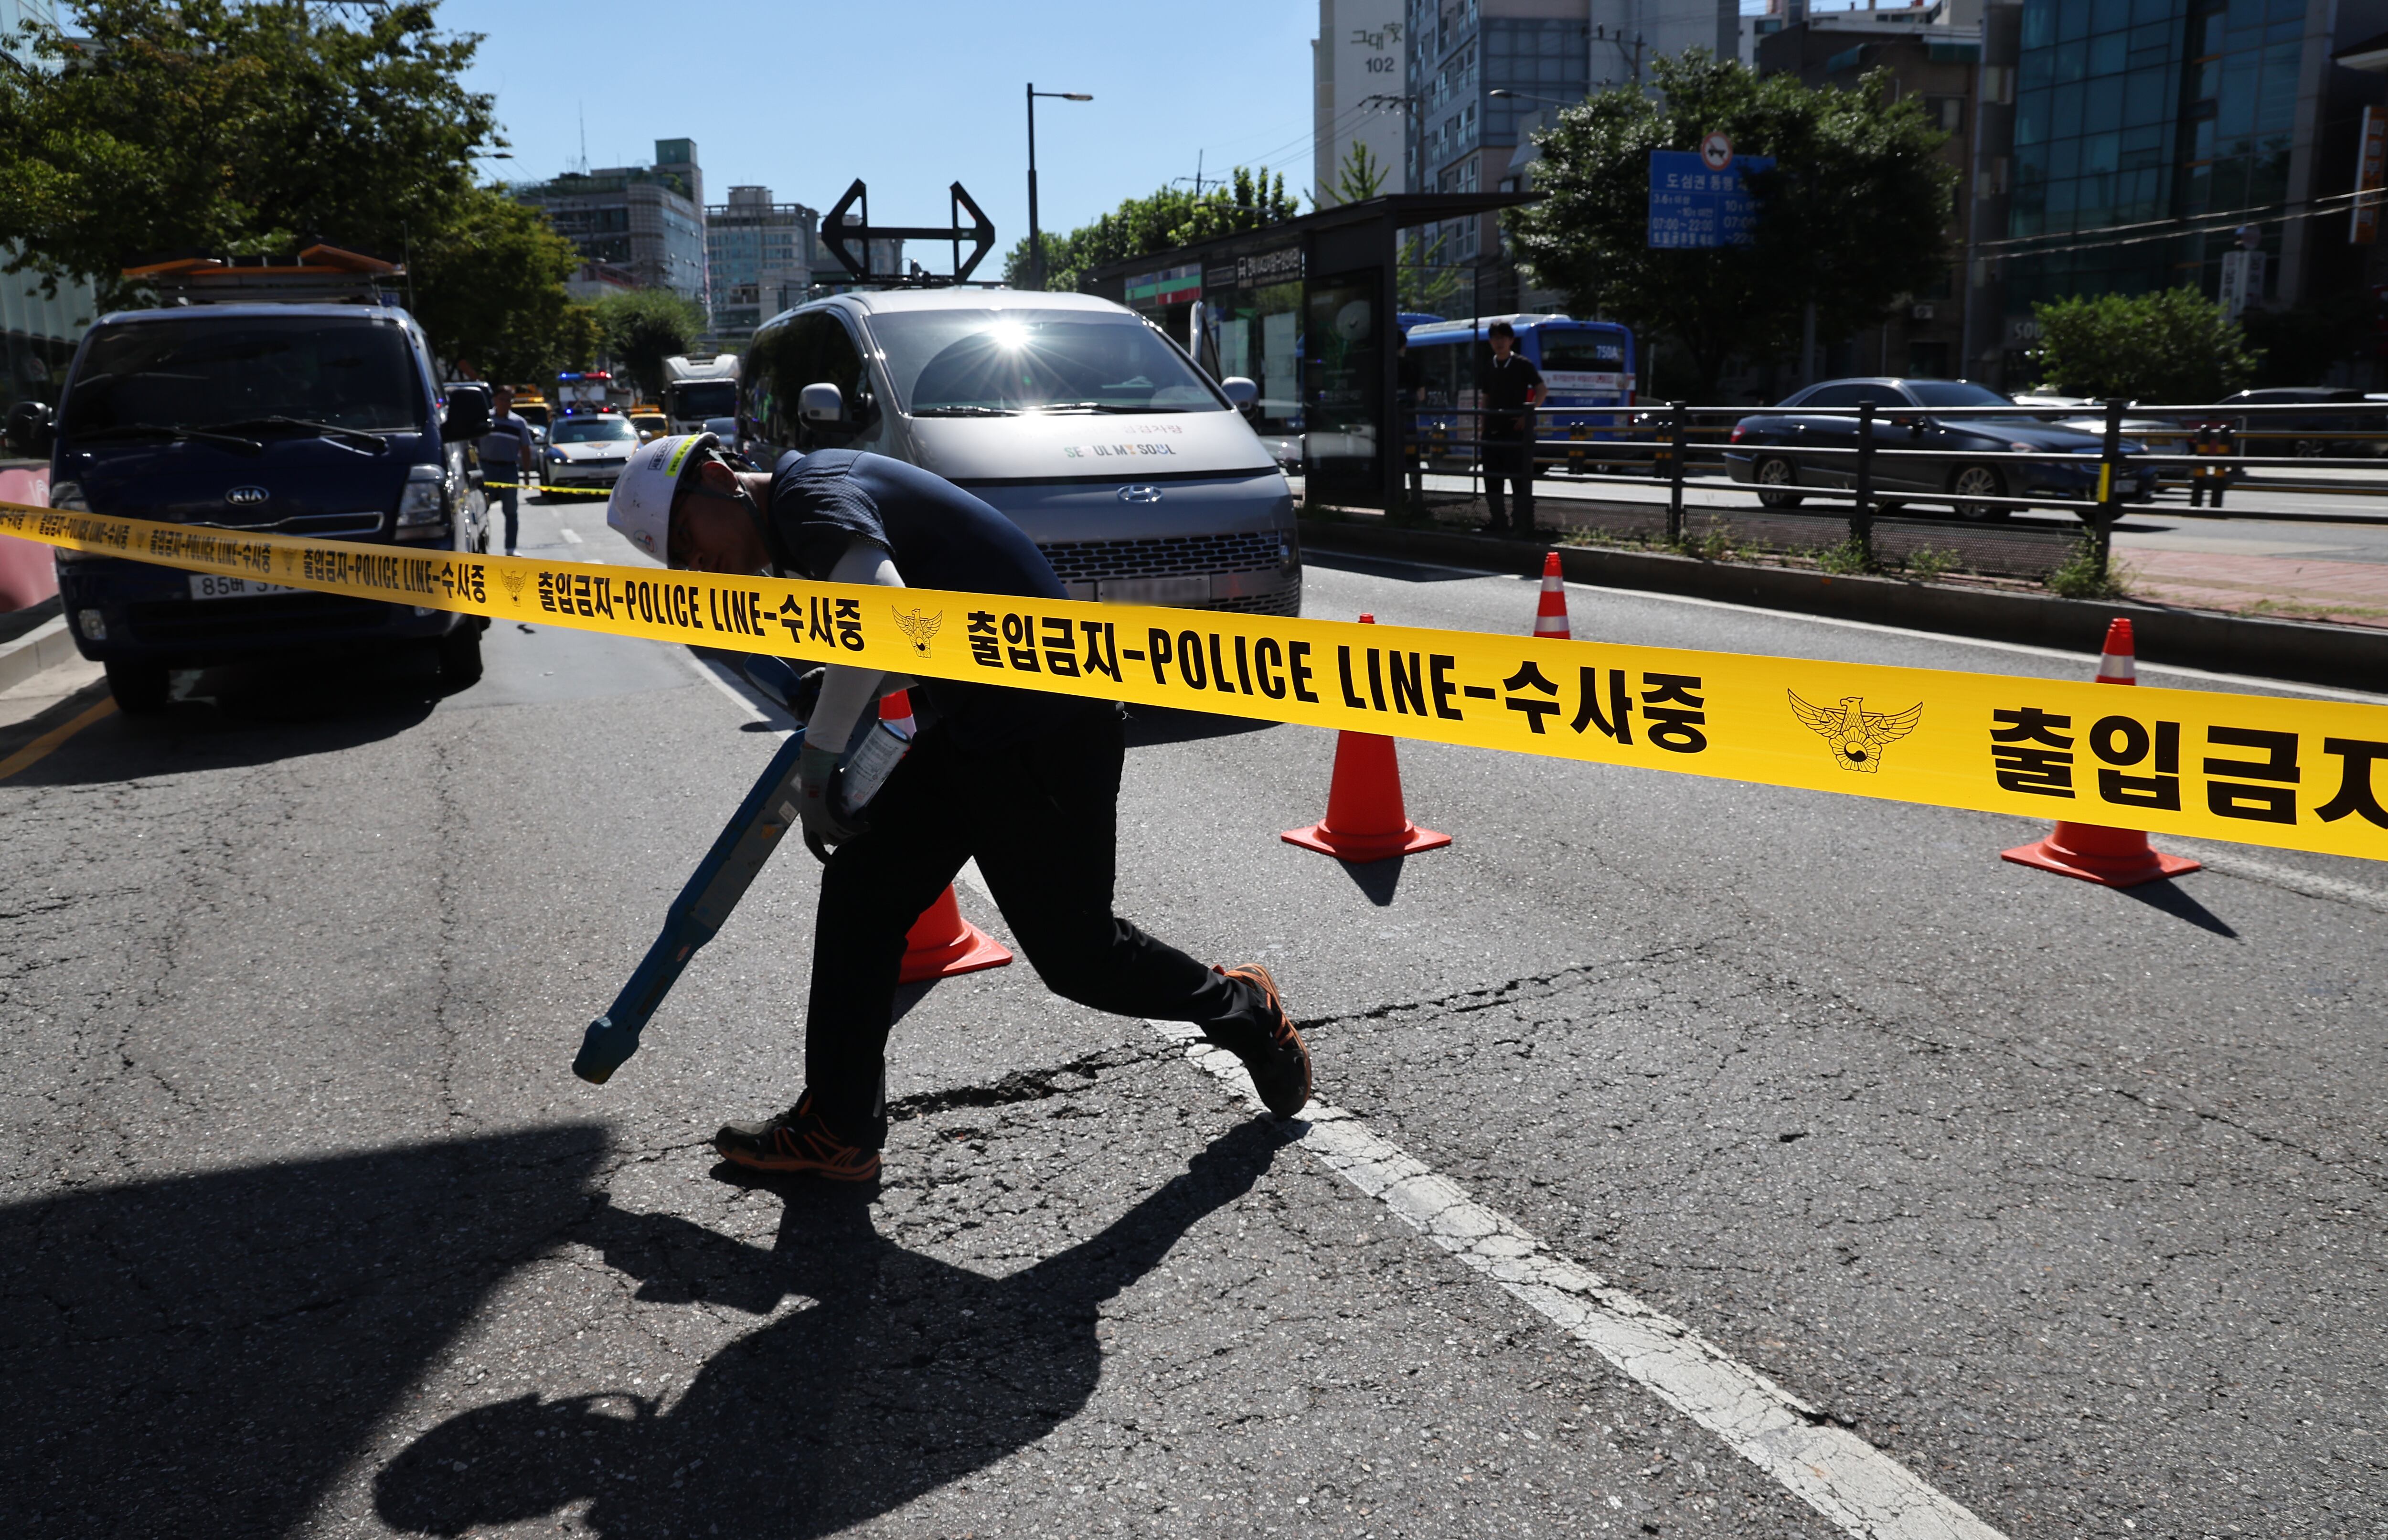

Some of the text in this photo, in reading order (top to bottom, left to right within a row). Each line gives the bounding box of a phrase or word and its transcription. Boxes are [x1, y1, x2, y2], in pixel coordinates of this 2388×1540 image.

[1365, 57, 1394, 73] 102
[1666, 173, 1706, 190] 도심권
[233, 489, 262, 502] KIA
[538, 571, 865, 652] 출입금지-POLICE LINE-수사중
[966, 610, 1708, 754] 출입금지-POLICE LINE-수사중
